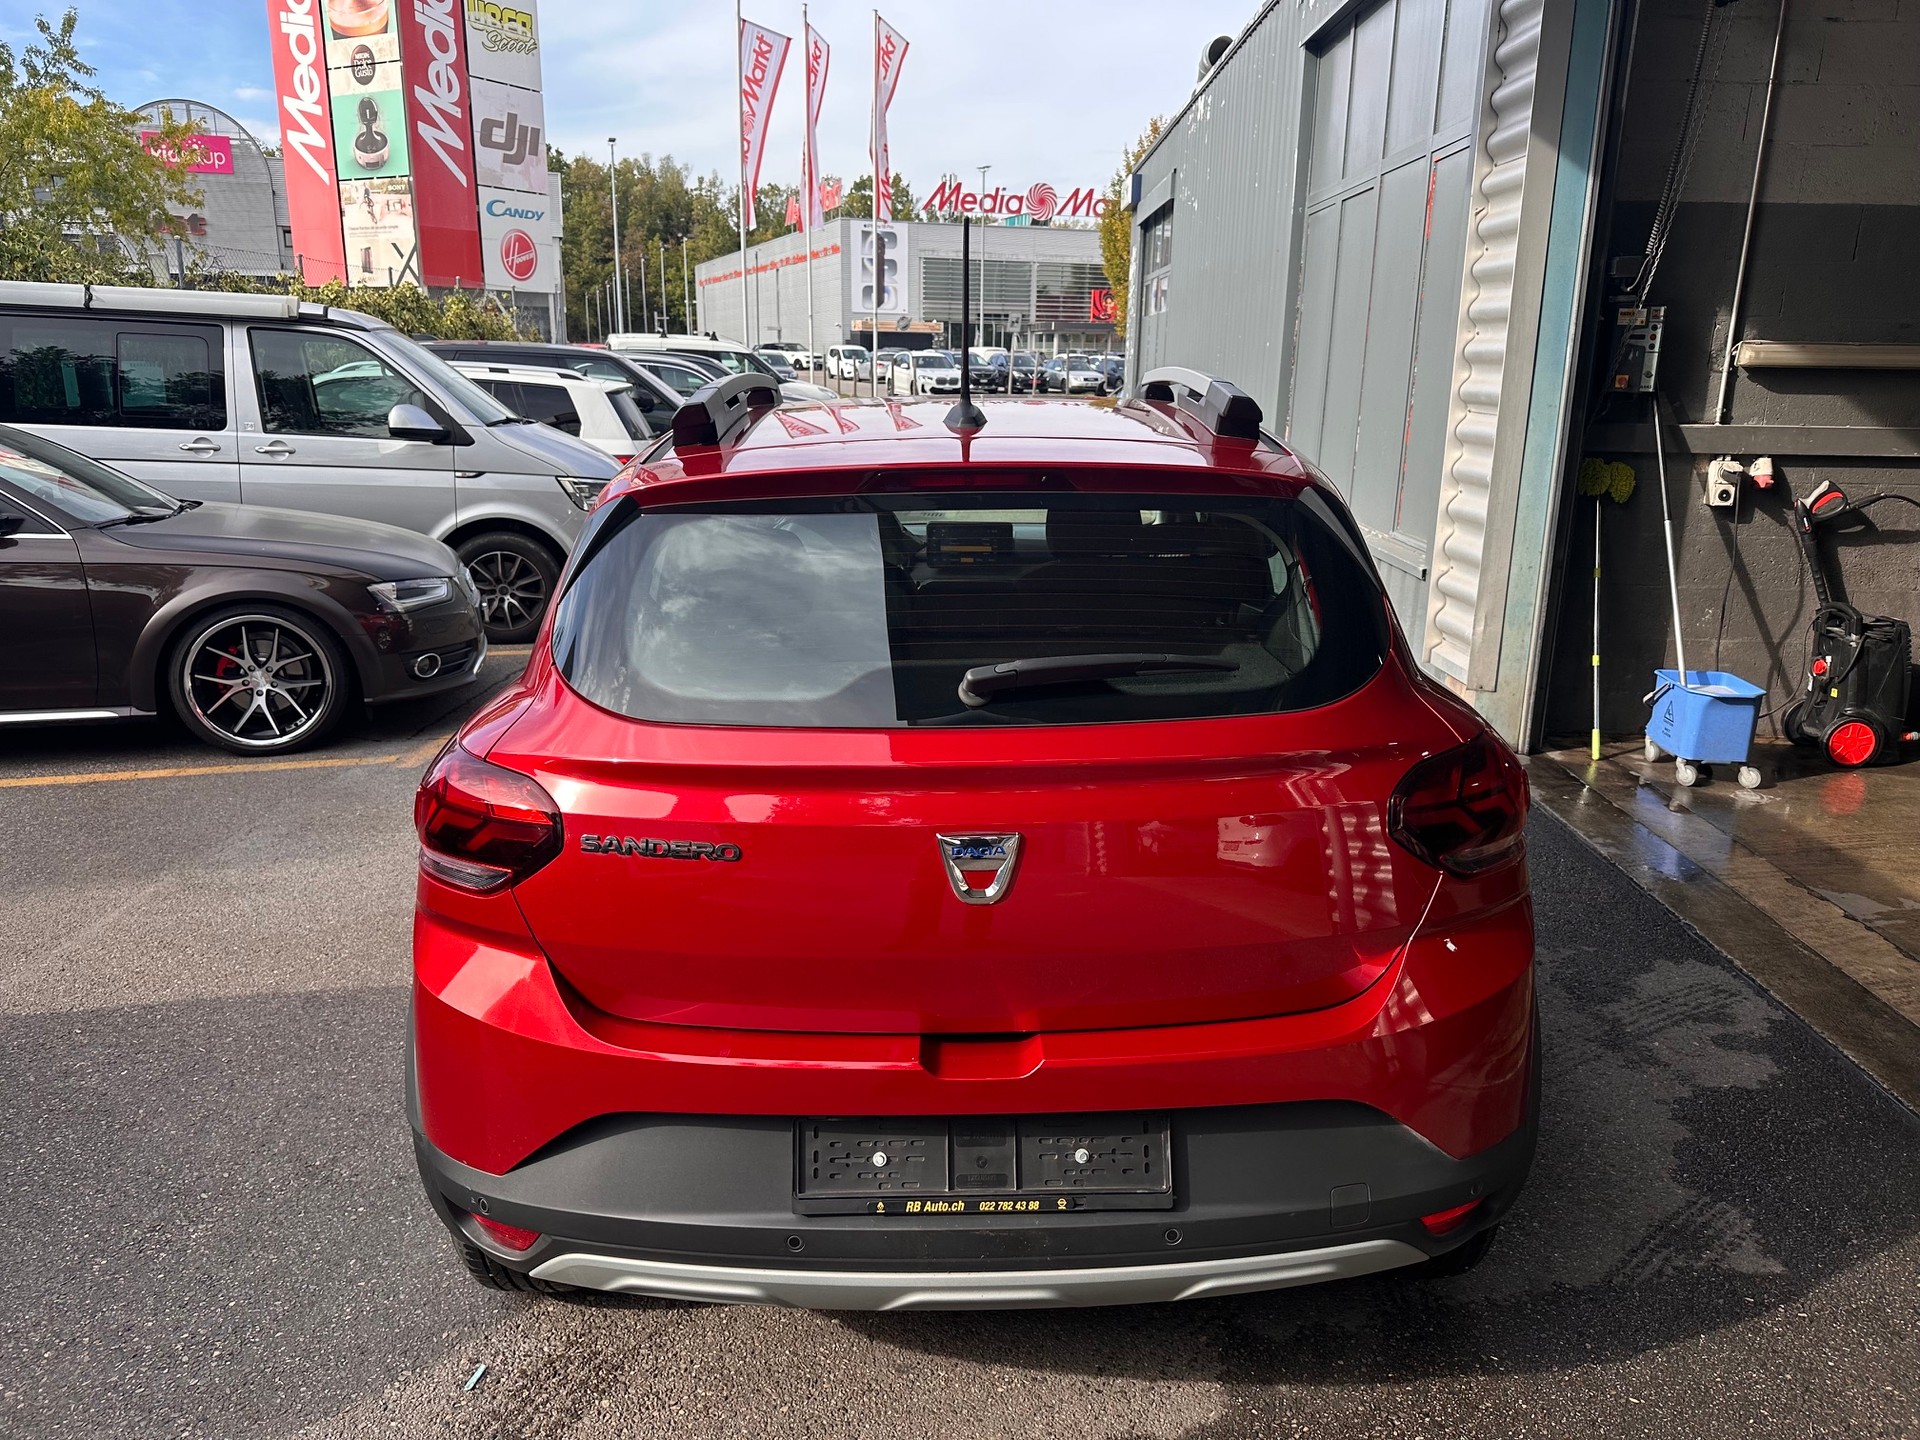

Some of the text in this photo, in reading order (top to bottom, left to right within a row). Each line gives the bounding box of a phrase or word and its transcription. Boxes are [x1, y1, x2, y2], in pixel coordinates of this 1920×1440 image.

[482, 29, 538, 55] Scoot
[742, 31, 774, 119] Markt
[480, 111, 541, 166] dji
[387, 184, 406, 192] SONY
[922, 181, 1024, 215] Media
[486, 199, 545, 221] CANDY
[580, 833, 742, 862] SANDERO
[950, 844, 1007, 859] DACIA
[905, 1200, 1040, 1213] RB Auto.ch 022 782 43 88
